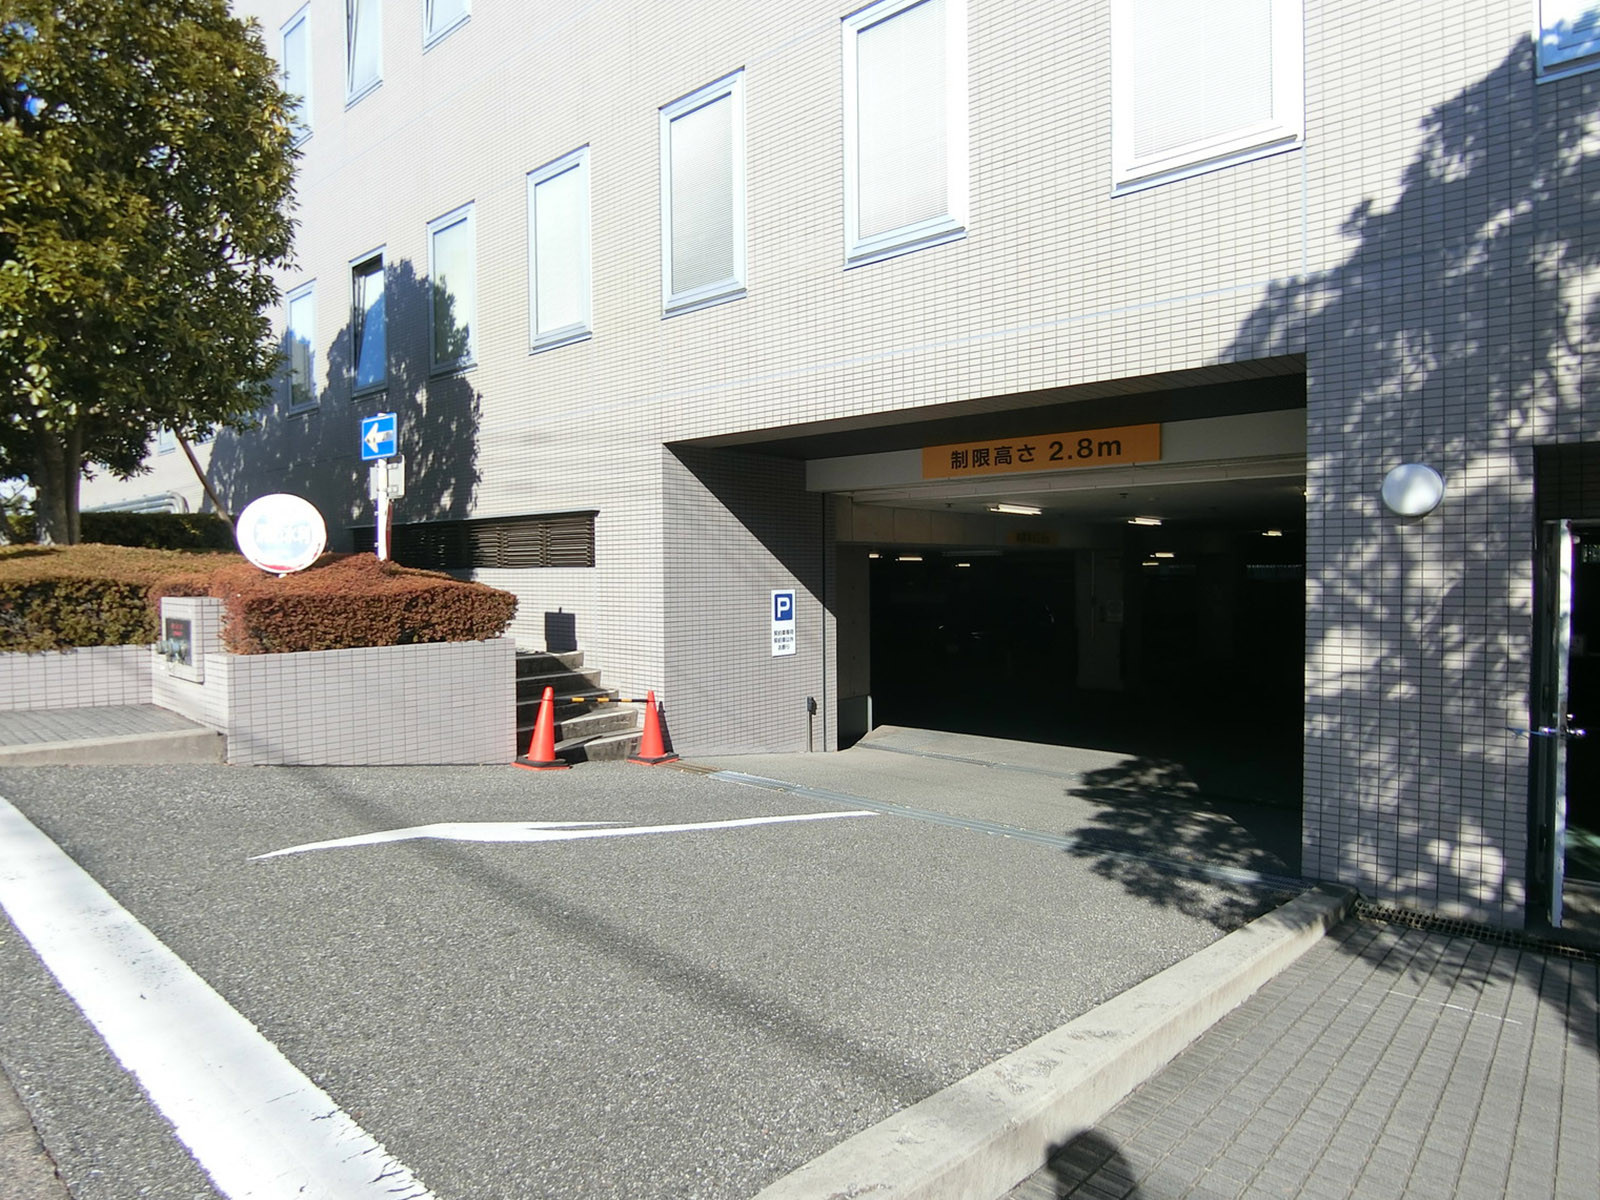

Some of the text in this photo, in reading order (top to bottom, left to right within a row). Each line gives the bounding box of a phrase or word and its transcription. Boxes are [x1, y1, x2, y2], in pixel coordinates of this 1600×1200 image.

[950, 438, 1122, 470] 制限高さ 2.8m
[777, 597, 790, 618] P
